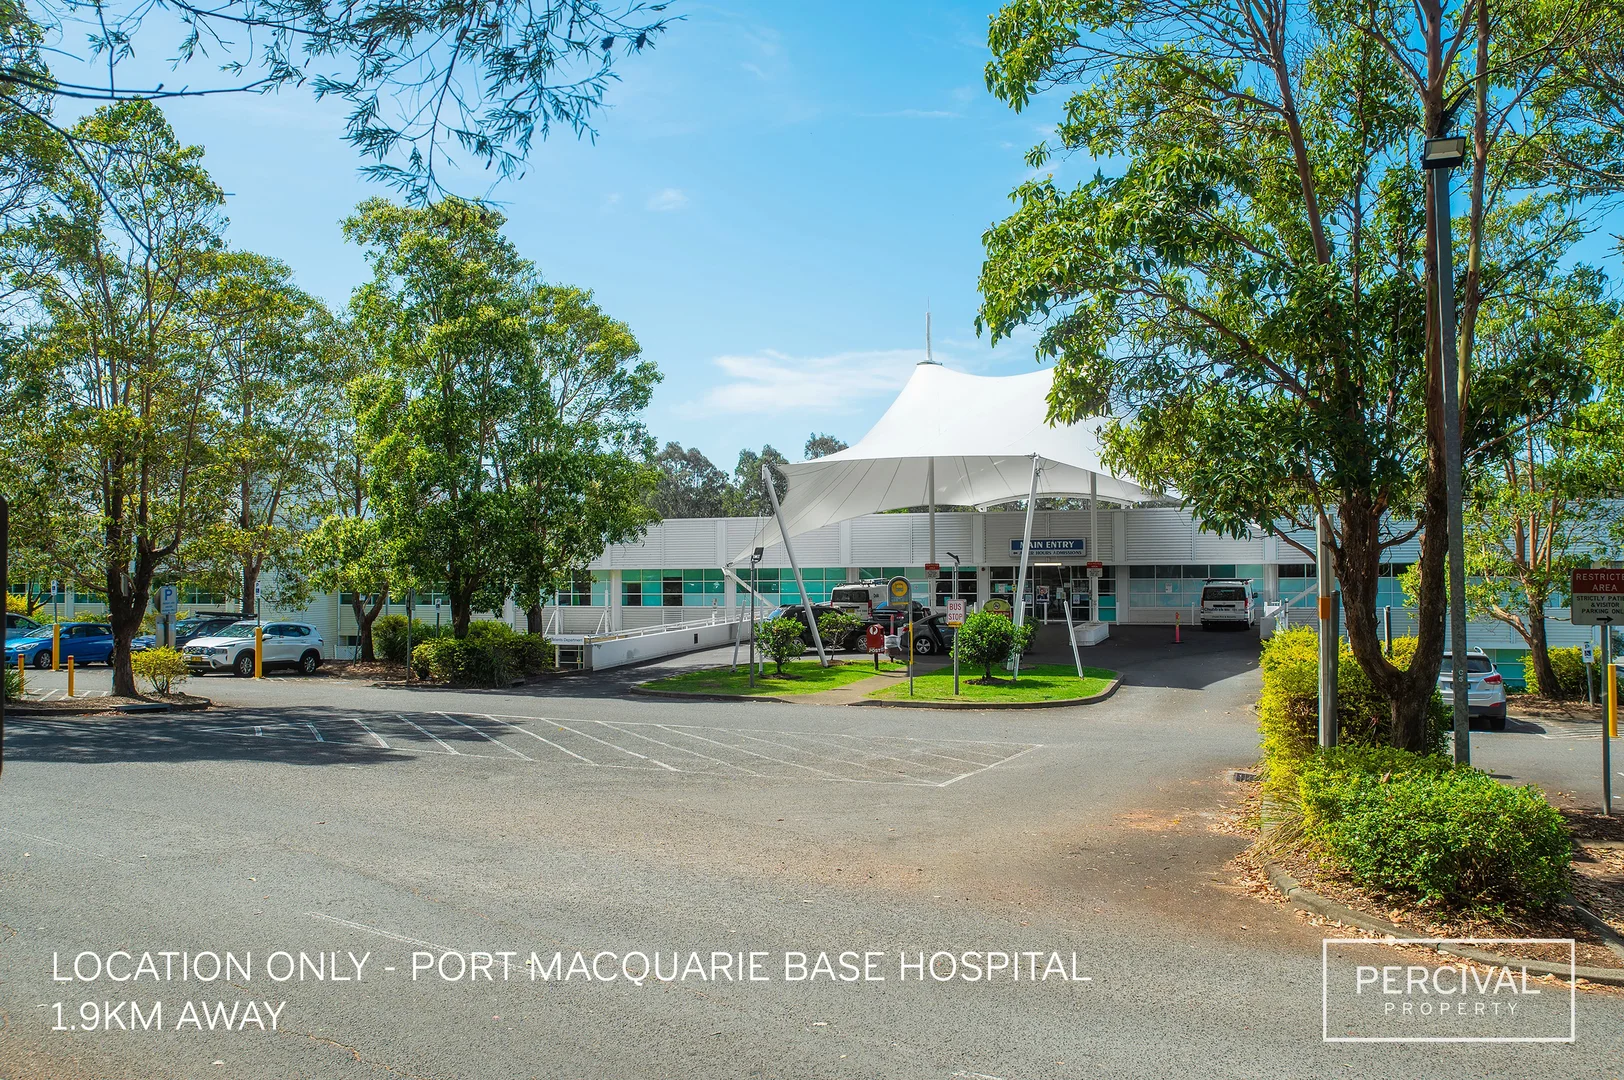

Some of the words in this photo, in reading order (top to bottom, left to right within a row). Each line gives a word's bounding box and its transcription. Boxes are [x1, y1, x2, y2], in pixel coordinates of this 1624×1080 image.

[1046, 541, 1075, 549] ENTRY
[1592, 584, 1618, 592] AREA
[164, 589, 173, 601] P
[949, 603, 962, 611] BUS
[948, 613, 963, 621] STOP
